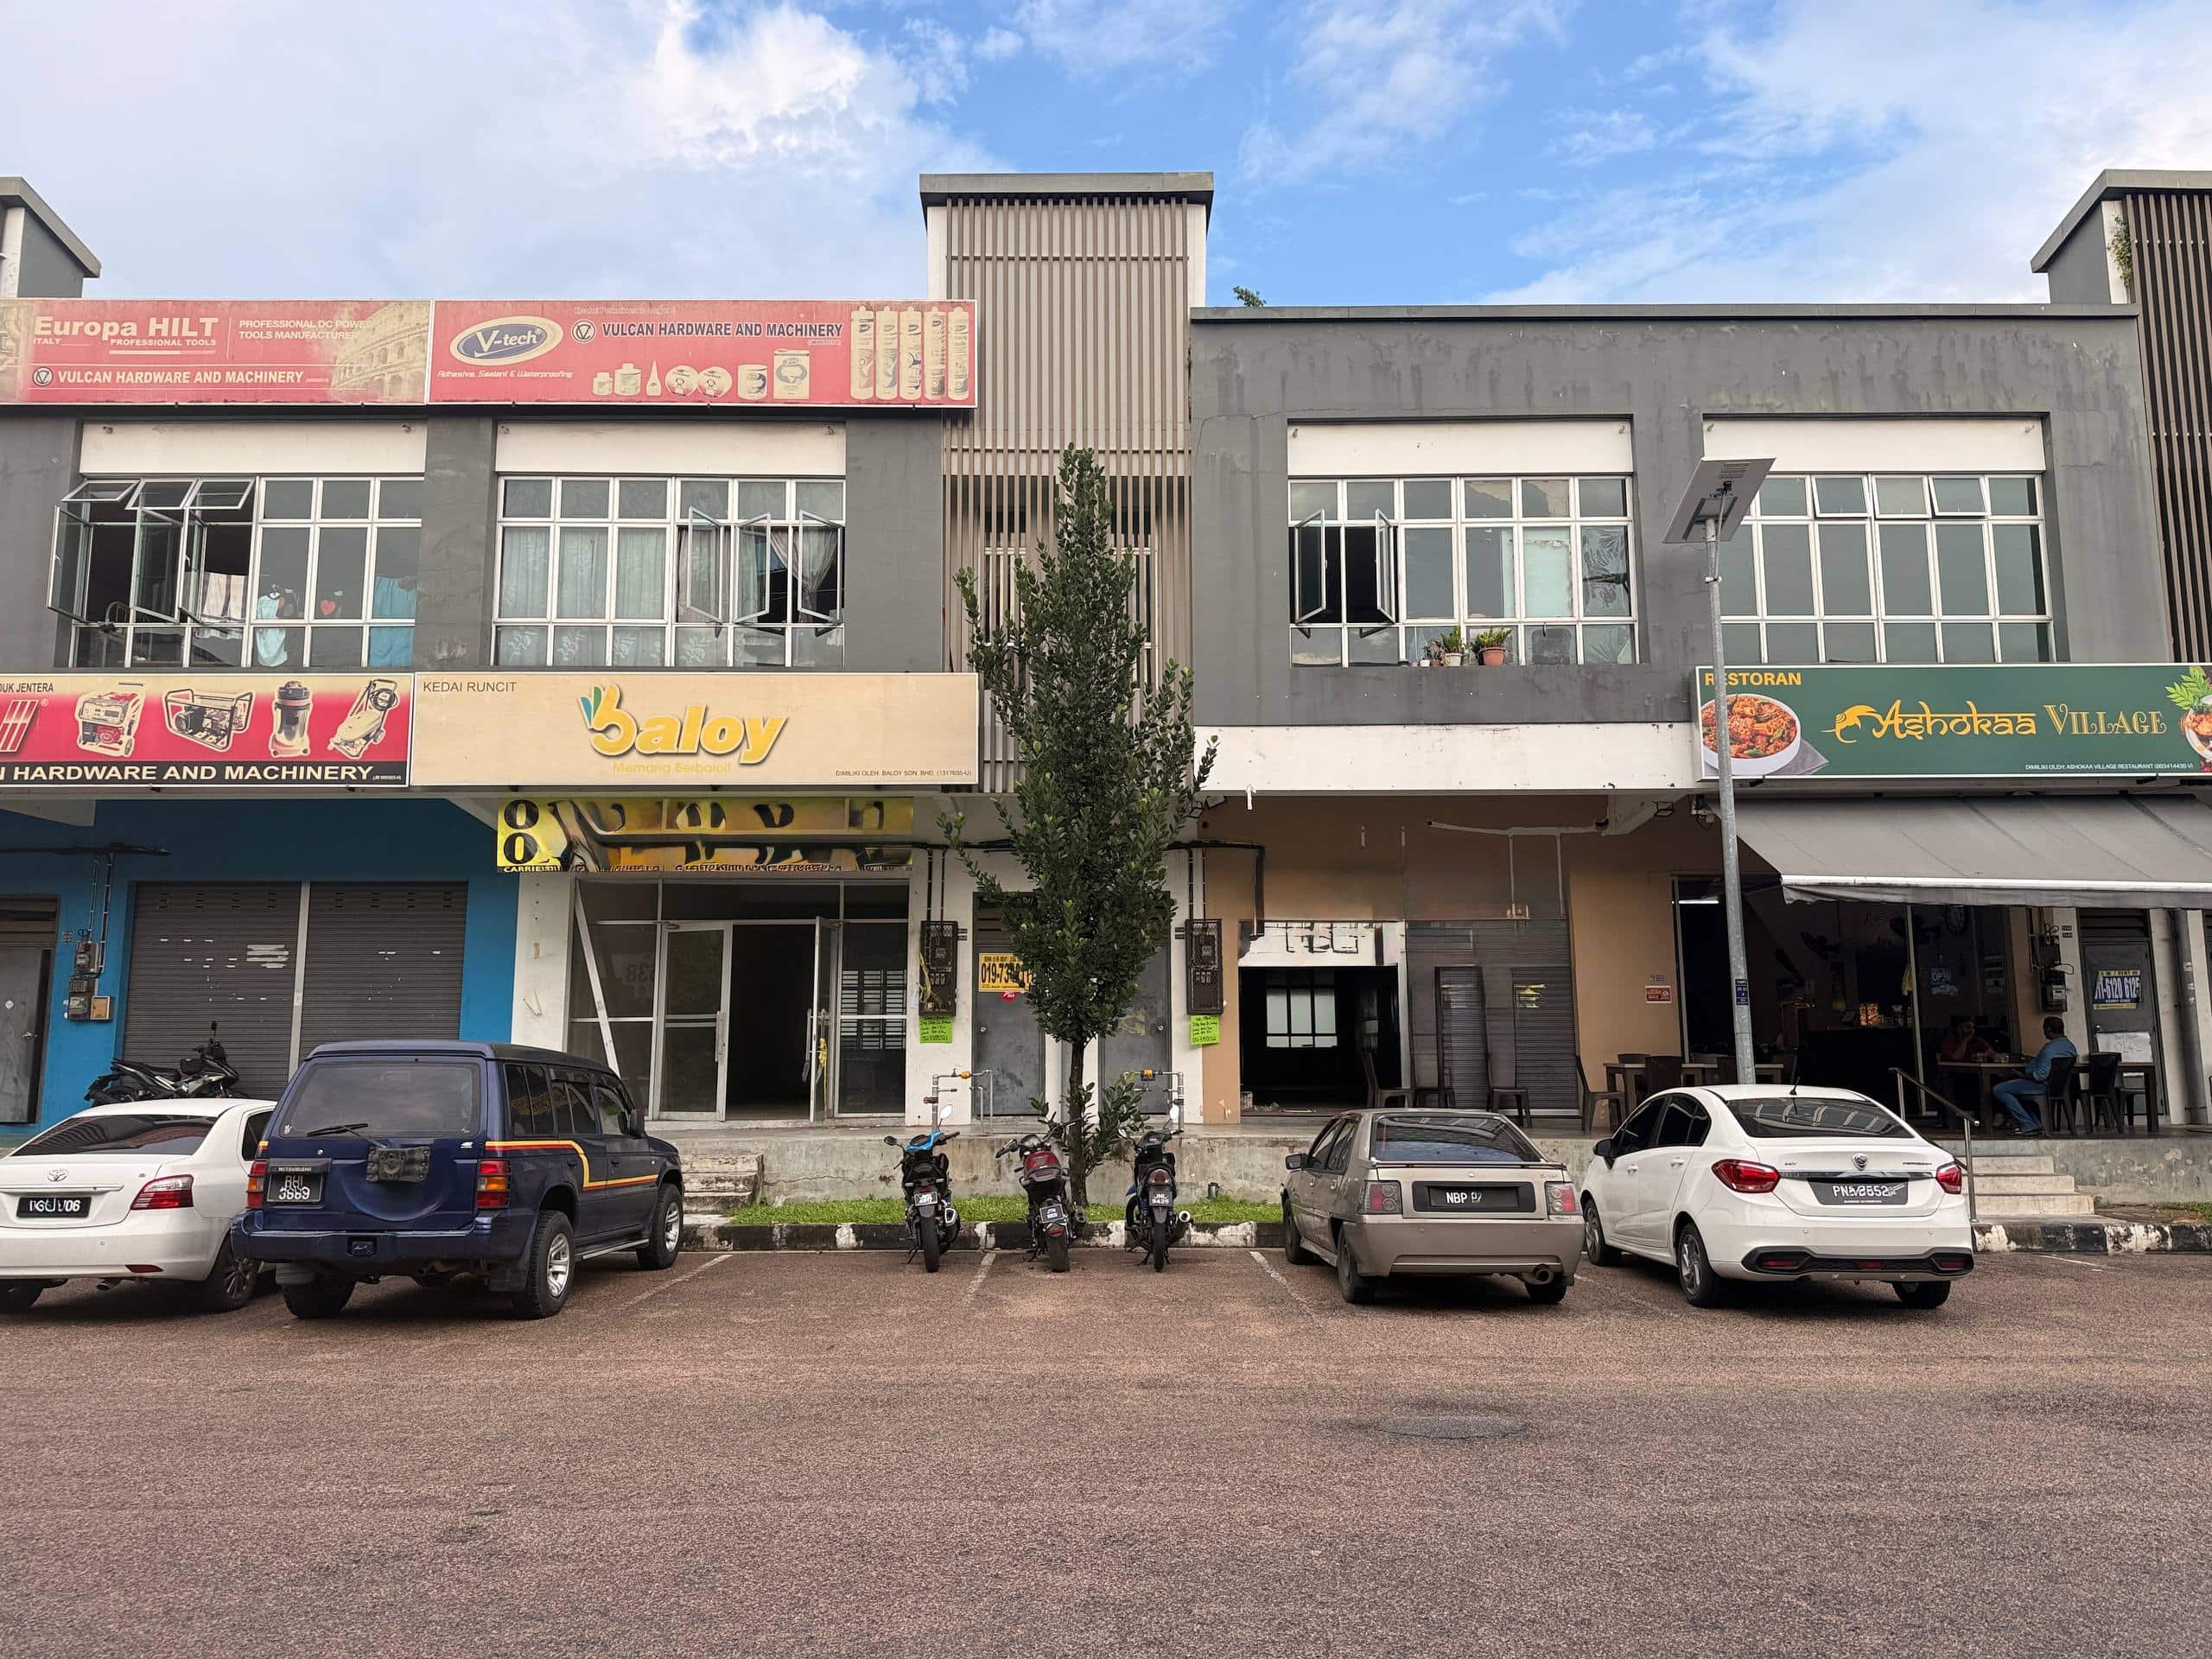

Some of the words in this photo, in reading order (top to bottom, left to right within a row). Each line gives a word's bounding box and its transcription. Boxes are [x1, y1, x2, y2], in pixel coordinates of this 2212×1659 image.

[35, 316, 137, 341] Europa
[148, 317, 219, 337] HILT
[238, 320, 315, 328] PROFESSIONAL
[318, 320, 334, 328] DC
[335, 320, 372, 329] POWE
[602, 322, 654, 336] VULCAN
[658, 323, 731, 336] HARDWARE
[734, 323, 762, 336] AND
[766, 323, 843, 337] MACHINERY
[238, 331, 273, 340] TOOLS
[475, 329, 537, 353] V-tech
[58, 372, 111, 384] VULCAN
[116, 372, 190, 384] HARDWARE
[194, 372, 222, 384] AND
[225, 372, 304, 384] MACHINERY
[1705, 672, 1802, 685] RSTORAN
[16, 683, 54, 692] JENTERA
[423, 682, 462, 692] KEDAI
[467, 682, 518, 692] RUNCIT
[579, 683, 788, 765] baloy
[13, 766, 156, 780] HARDWARE
[163, 766, 217, 780] AND
[225, 766, 374, 780] MACHINERY
[613, 762, 671, 775] Memang
[1446, 1192, 1468, 1204] NBP
